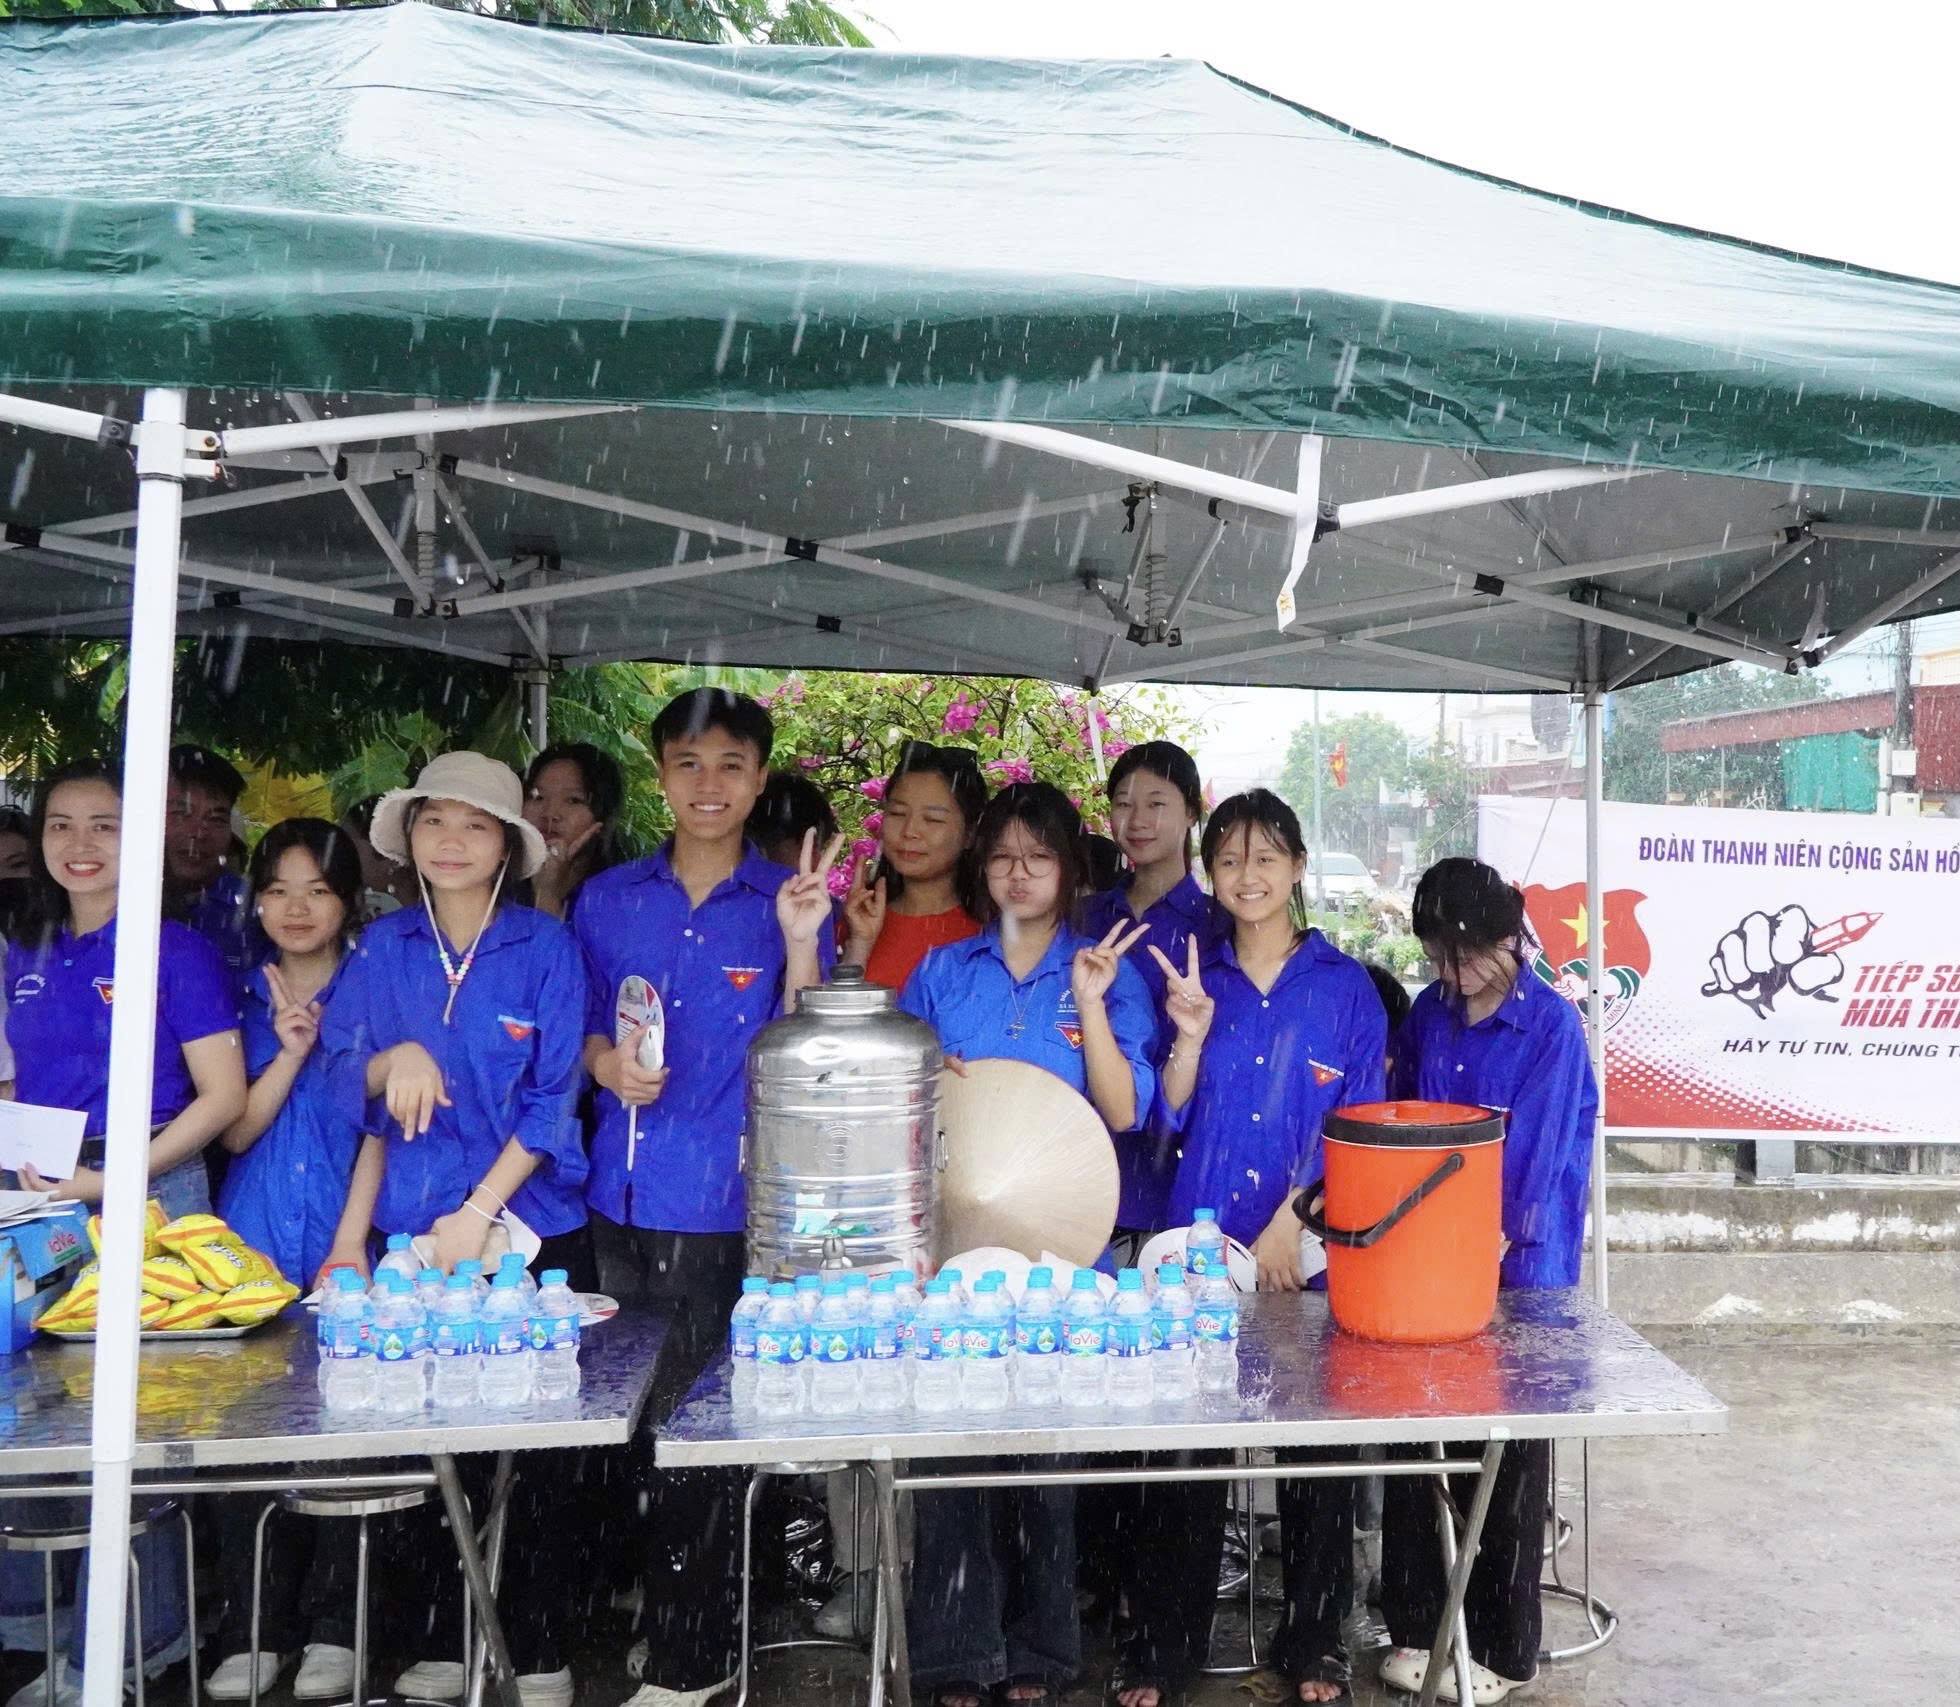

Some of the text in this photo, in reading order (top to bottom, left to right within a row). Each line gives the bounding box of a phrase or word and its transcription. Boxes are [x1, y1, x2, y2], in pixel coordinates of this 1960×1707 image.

[1639, 832, 1695, 862] ĐOÀN
[1702, 839, 1767, 866] THANH
[1774, 838, 1822, 868] NIÊN
[1829, 840, 1882, 875] CỘNG
[1889, 840, 1928, 873] SẢN
[1853, 960, 1925, 993] TIẾP
[1840, 994, 1913, 1028] MÙA
[1723, 1037, 1960, 1058] HÃY TỰ TIN, CHÚNG T
